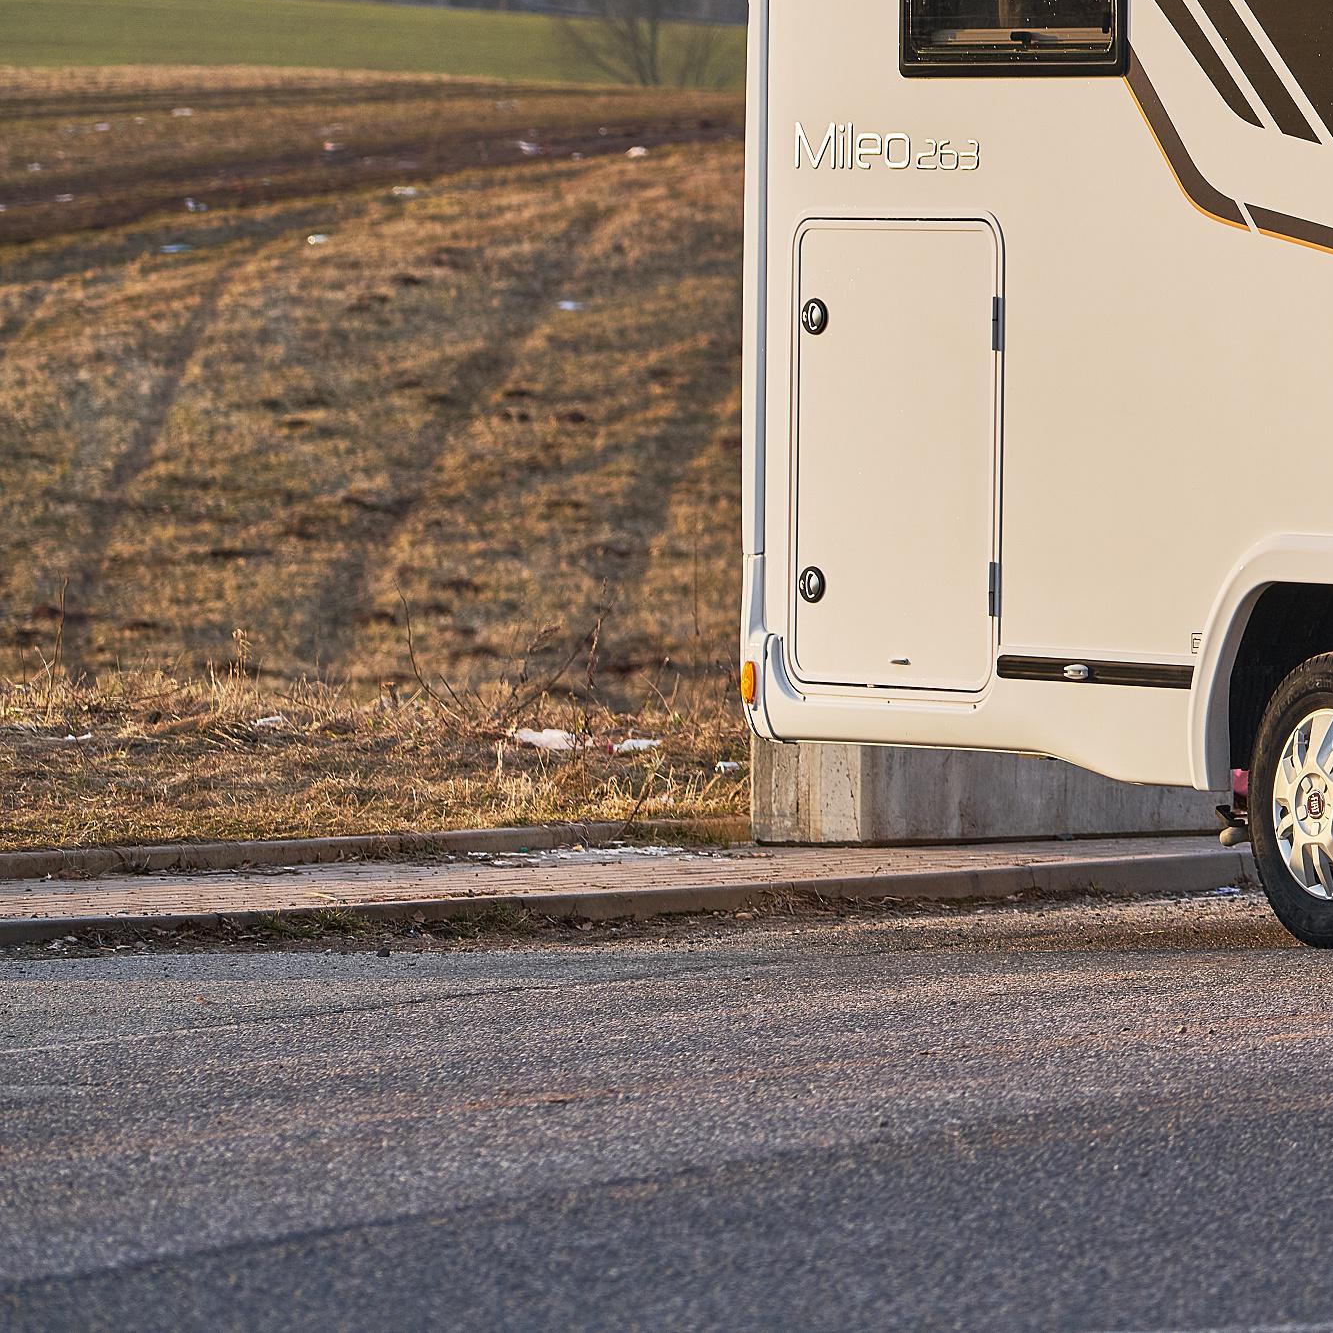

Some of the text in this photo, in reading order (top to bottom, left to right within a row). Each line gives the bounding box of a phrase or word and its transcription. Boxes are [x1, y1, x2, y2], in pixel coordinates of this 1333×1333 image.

[794, 121, 981, 170] Mileo 263
[1310, 795, 1320, 813] FIAT
